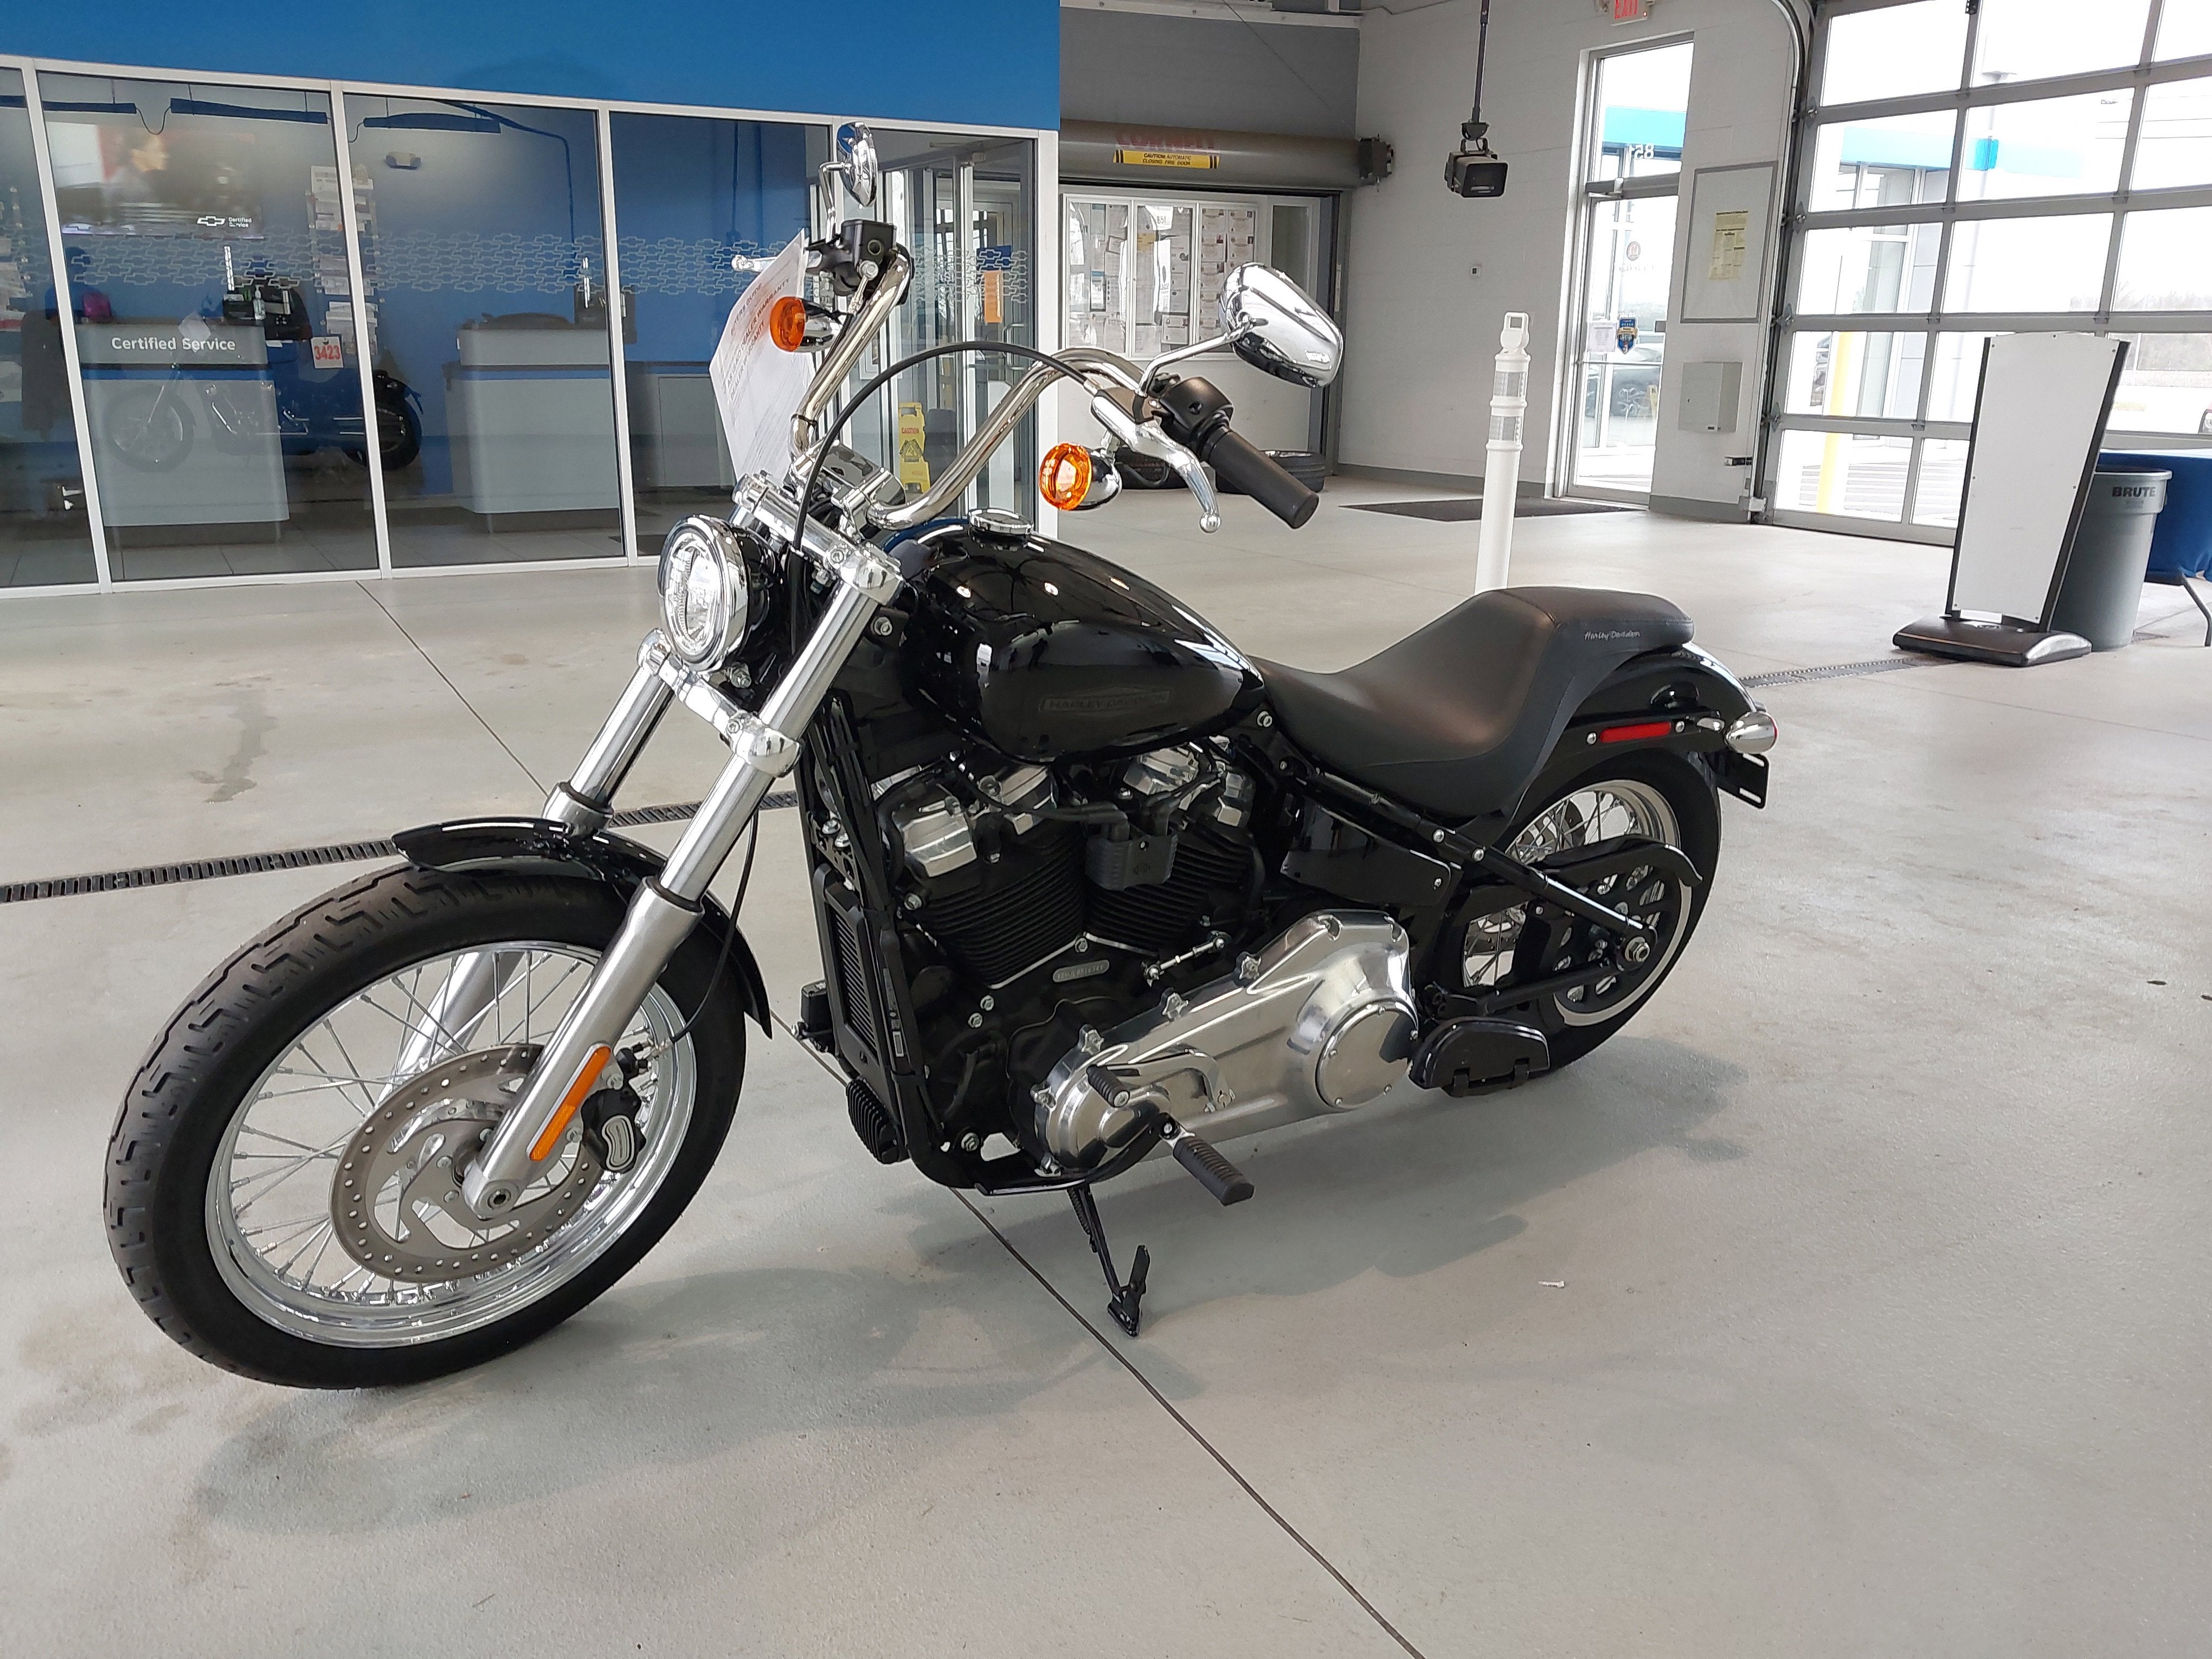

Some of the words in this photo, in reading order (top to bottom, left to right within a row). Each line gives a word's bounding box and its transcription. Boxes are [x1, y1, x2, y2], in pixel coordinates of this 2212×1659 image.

[757, 276, 790, 317] WARRANTY
[111, 337, 177, 350] Certified
[182, 337, 236, 350] Service
[314, 345, 341, 360] 3423
[2112, 486, 2156, 497] BRUTE
